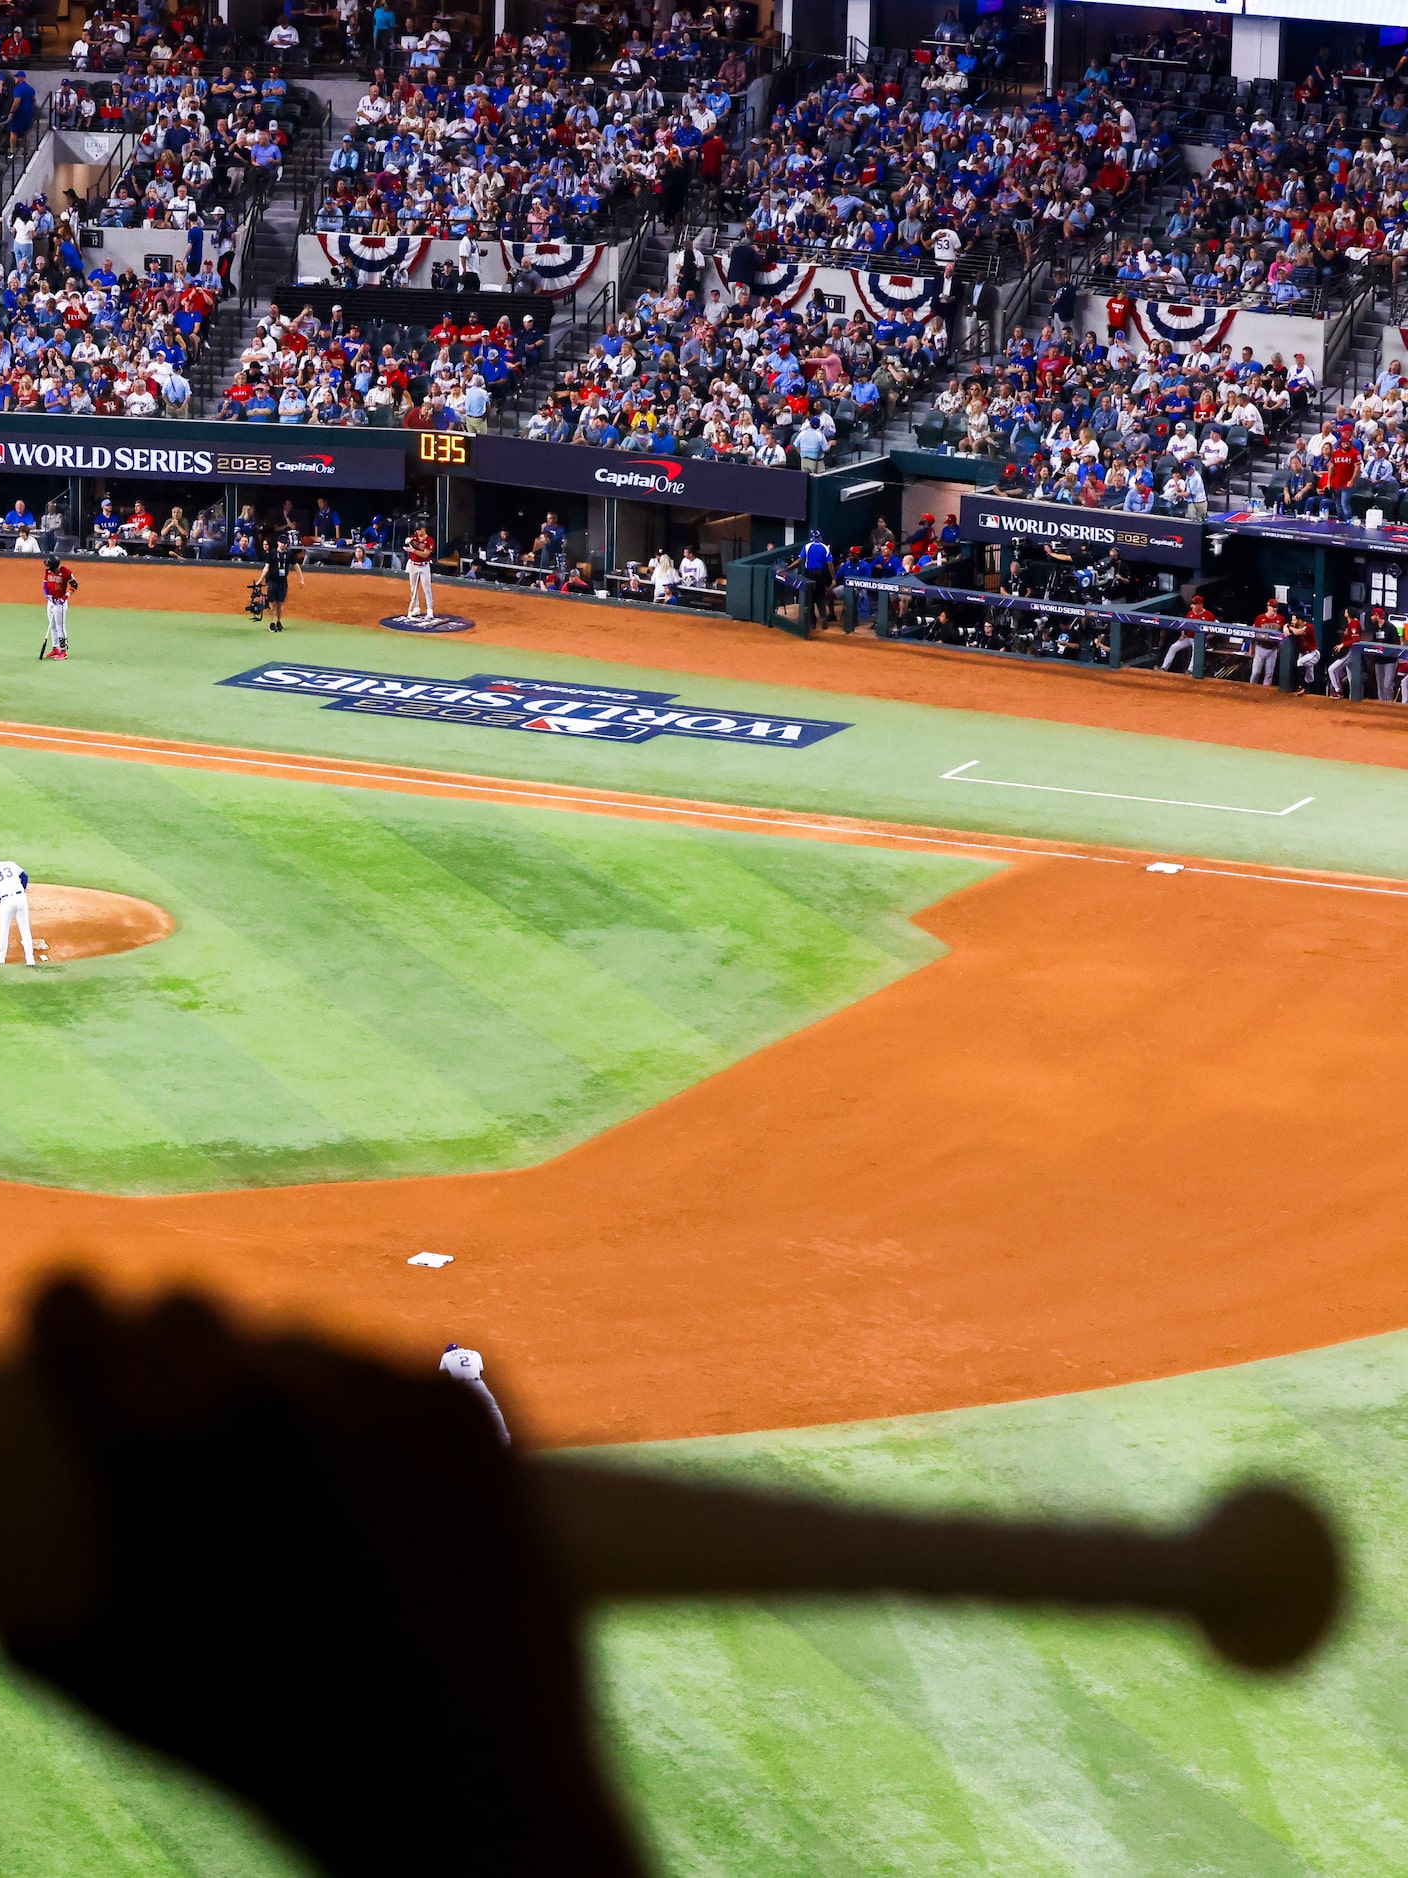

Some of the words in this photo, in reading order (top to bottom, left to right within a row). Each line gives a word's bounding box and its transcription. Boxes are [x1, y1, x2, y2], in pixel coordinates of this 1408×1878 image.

[936, 241, 949, 250] 53
[7, 443, 112, 471] WORLD
[114, 448, 212, 474] SERIES
[217, 457, 272, 471] 2023
[420, 433, 466, 463] 0:35
[1001, 515, 1059, 537] WORLD
[1059, 522, 1115, 544] SERIES
[1116, 533, 1148, 544] 2023
[854, 581, 877, 589] WORLD
[877, 583, 899, 592] SERIES
[1039, 604, 1063, 613] WORLD
[1063, 607, 1086, 616] SERIES
[1209, 626, 1233, 635] WORLD
[1233, 628, 1256, 638] SERIES
[253, 669, 524, 707] SERIES
[353, 699, 525, 724] 2023
[523, 698, 804, 741] WORLD
[459, 1356, 471, 1367] 2
